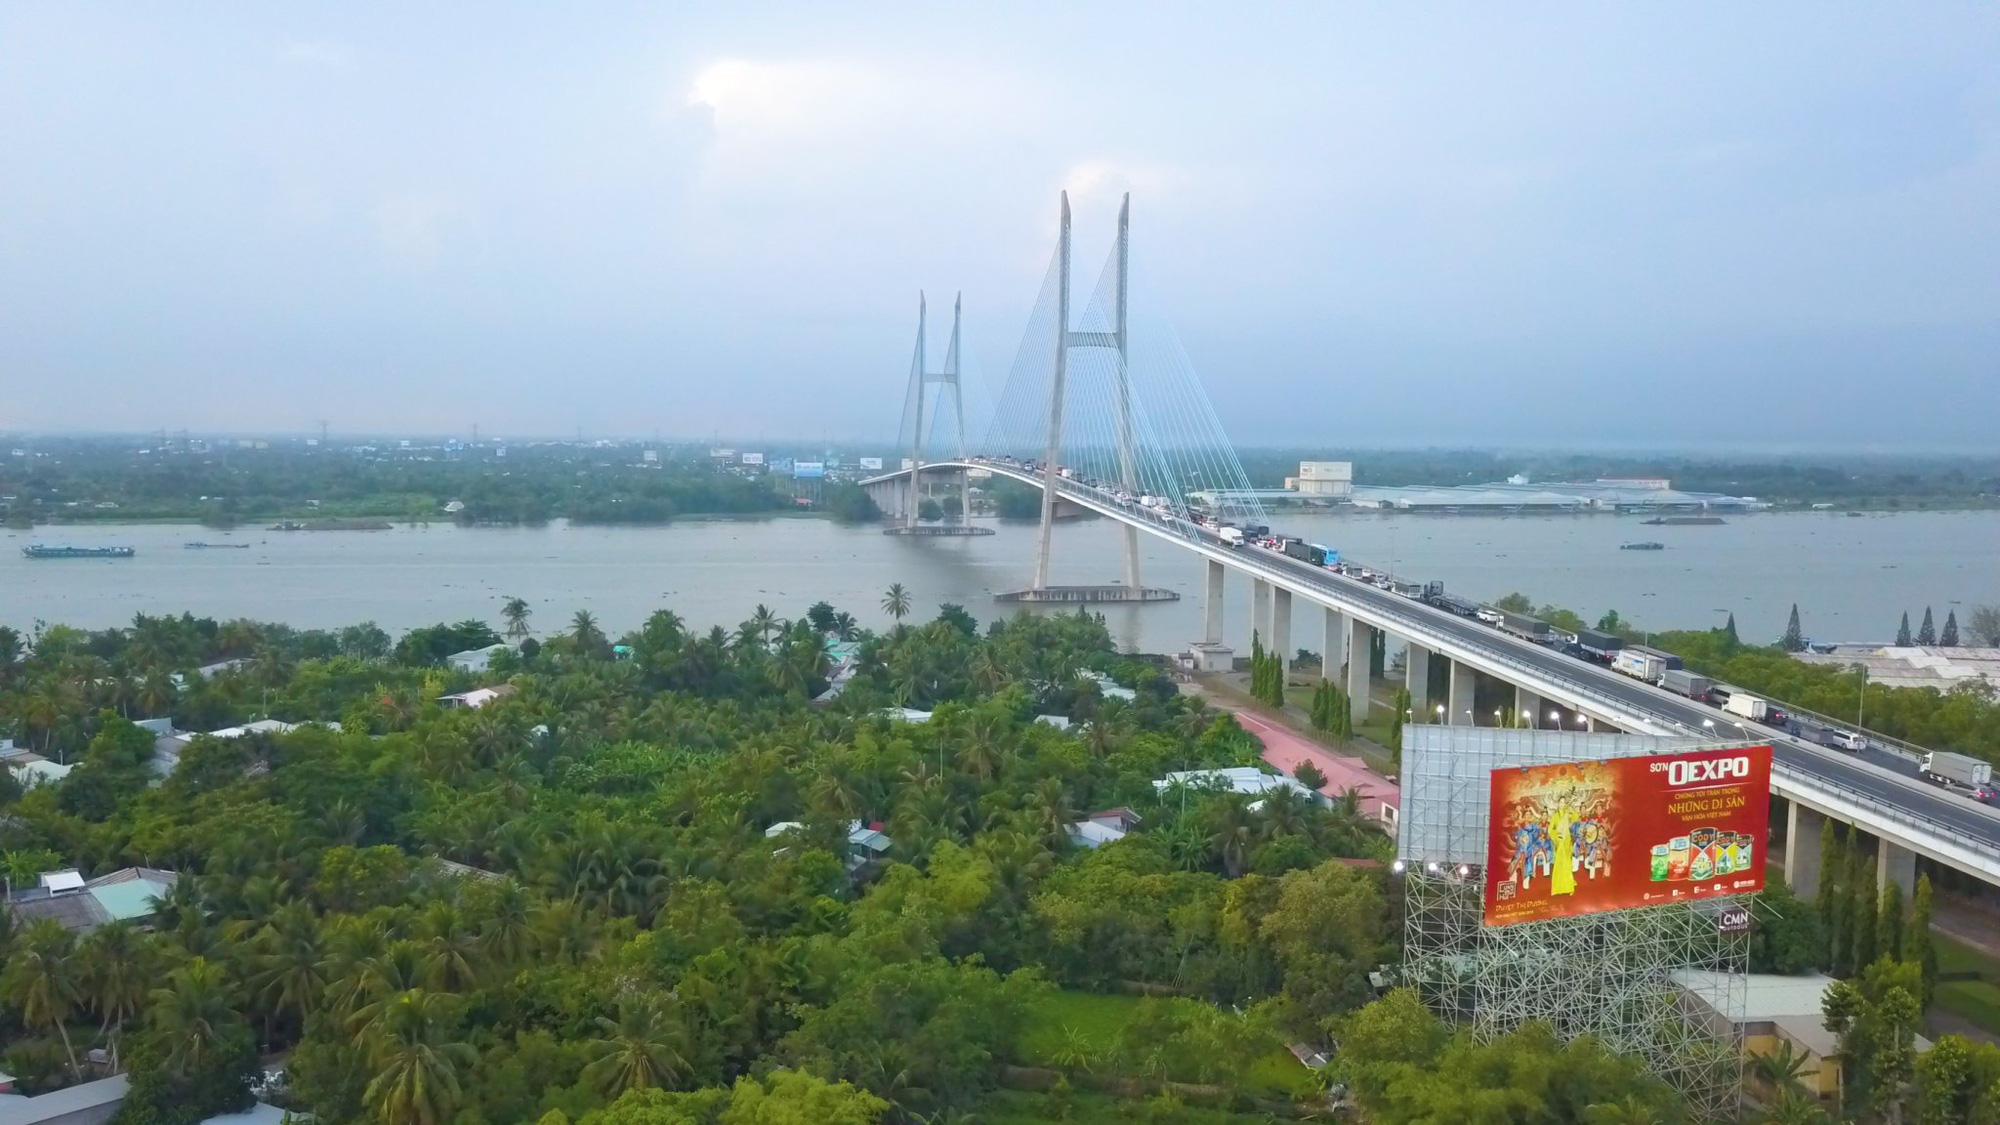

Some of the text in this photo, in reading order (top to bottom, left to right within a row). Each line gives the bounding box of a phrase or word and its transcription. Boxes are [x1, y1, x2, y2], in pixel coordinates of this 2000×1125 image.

[1650, 757, 1749, 786] SƠN OEXPO
[1712, 799, 1723, 809] DI
[1724, 912, 1748, 926] CMN
